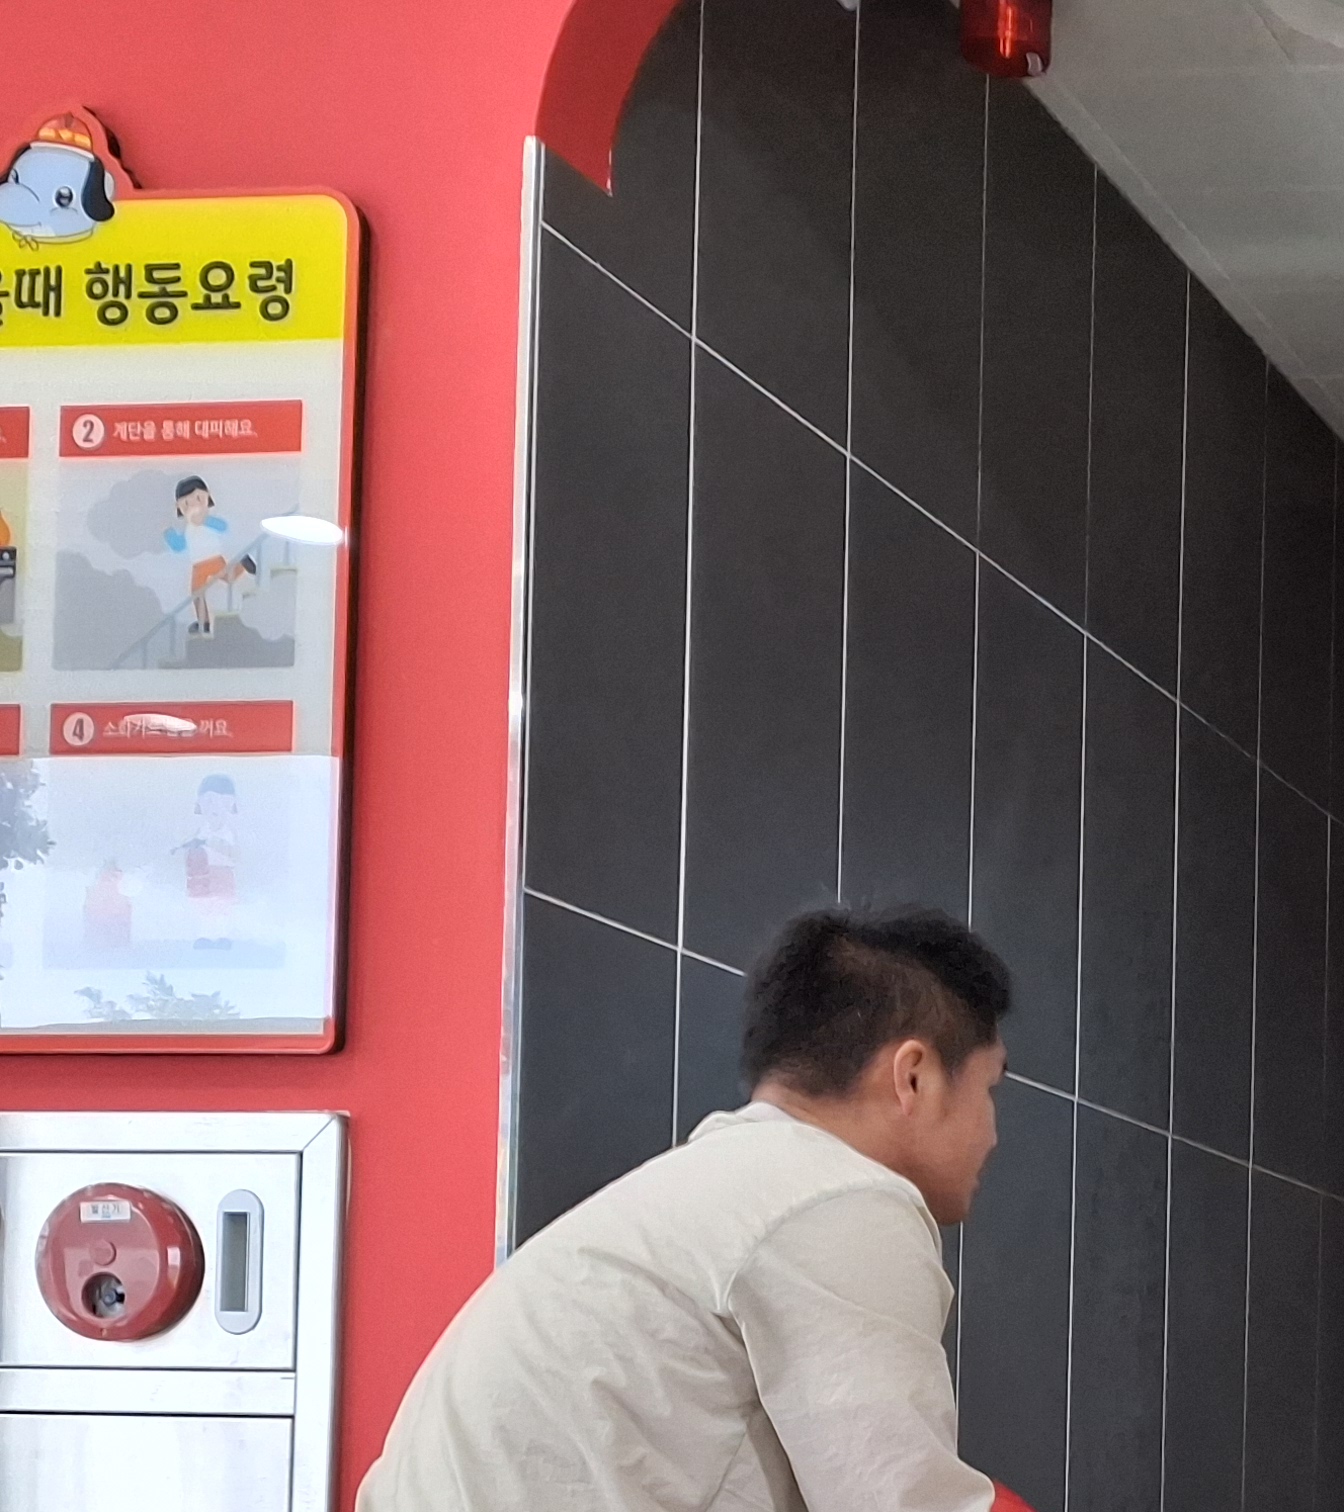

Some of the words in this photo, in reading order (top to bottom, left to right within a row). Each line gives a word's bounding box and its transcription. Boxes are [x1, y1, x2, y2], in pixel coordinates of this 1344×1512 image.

[0, 264, 62, 326] 때
[84, 258, 293, 326] 행동요령
[82, 420, 95, 443] 2
[113, 420, 156, 442] 계단을
[161, 420, 190, 441] 통해
